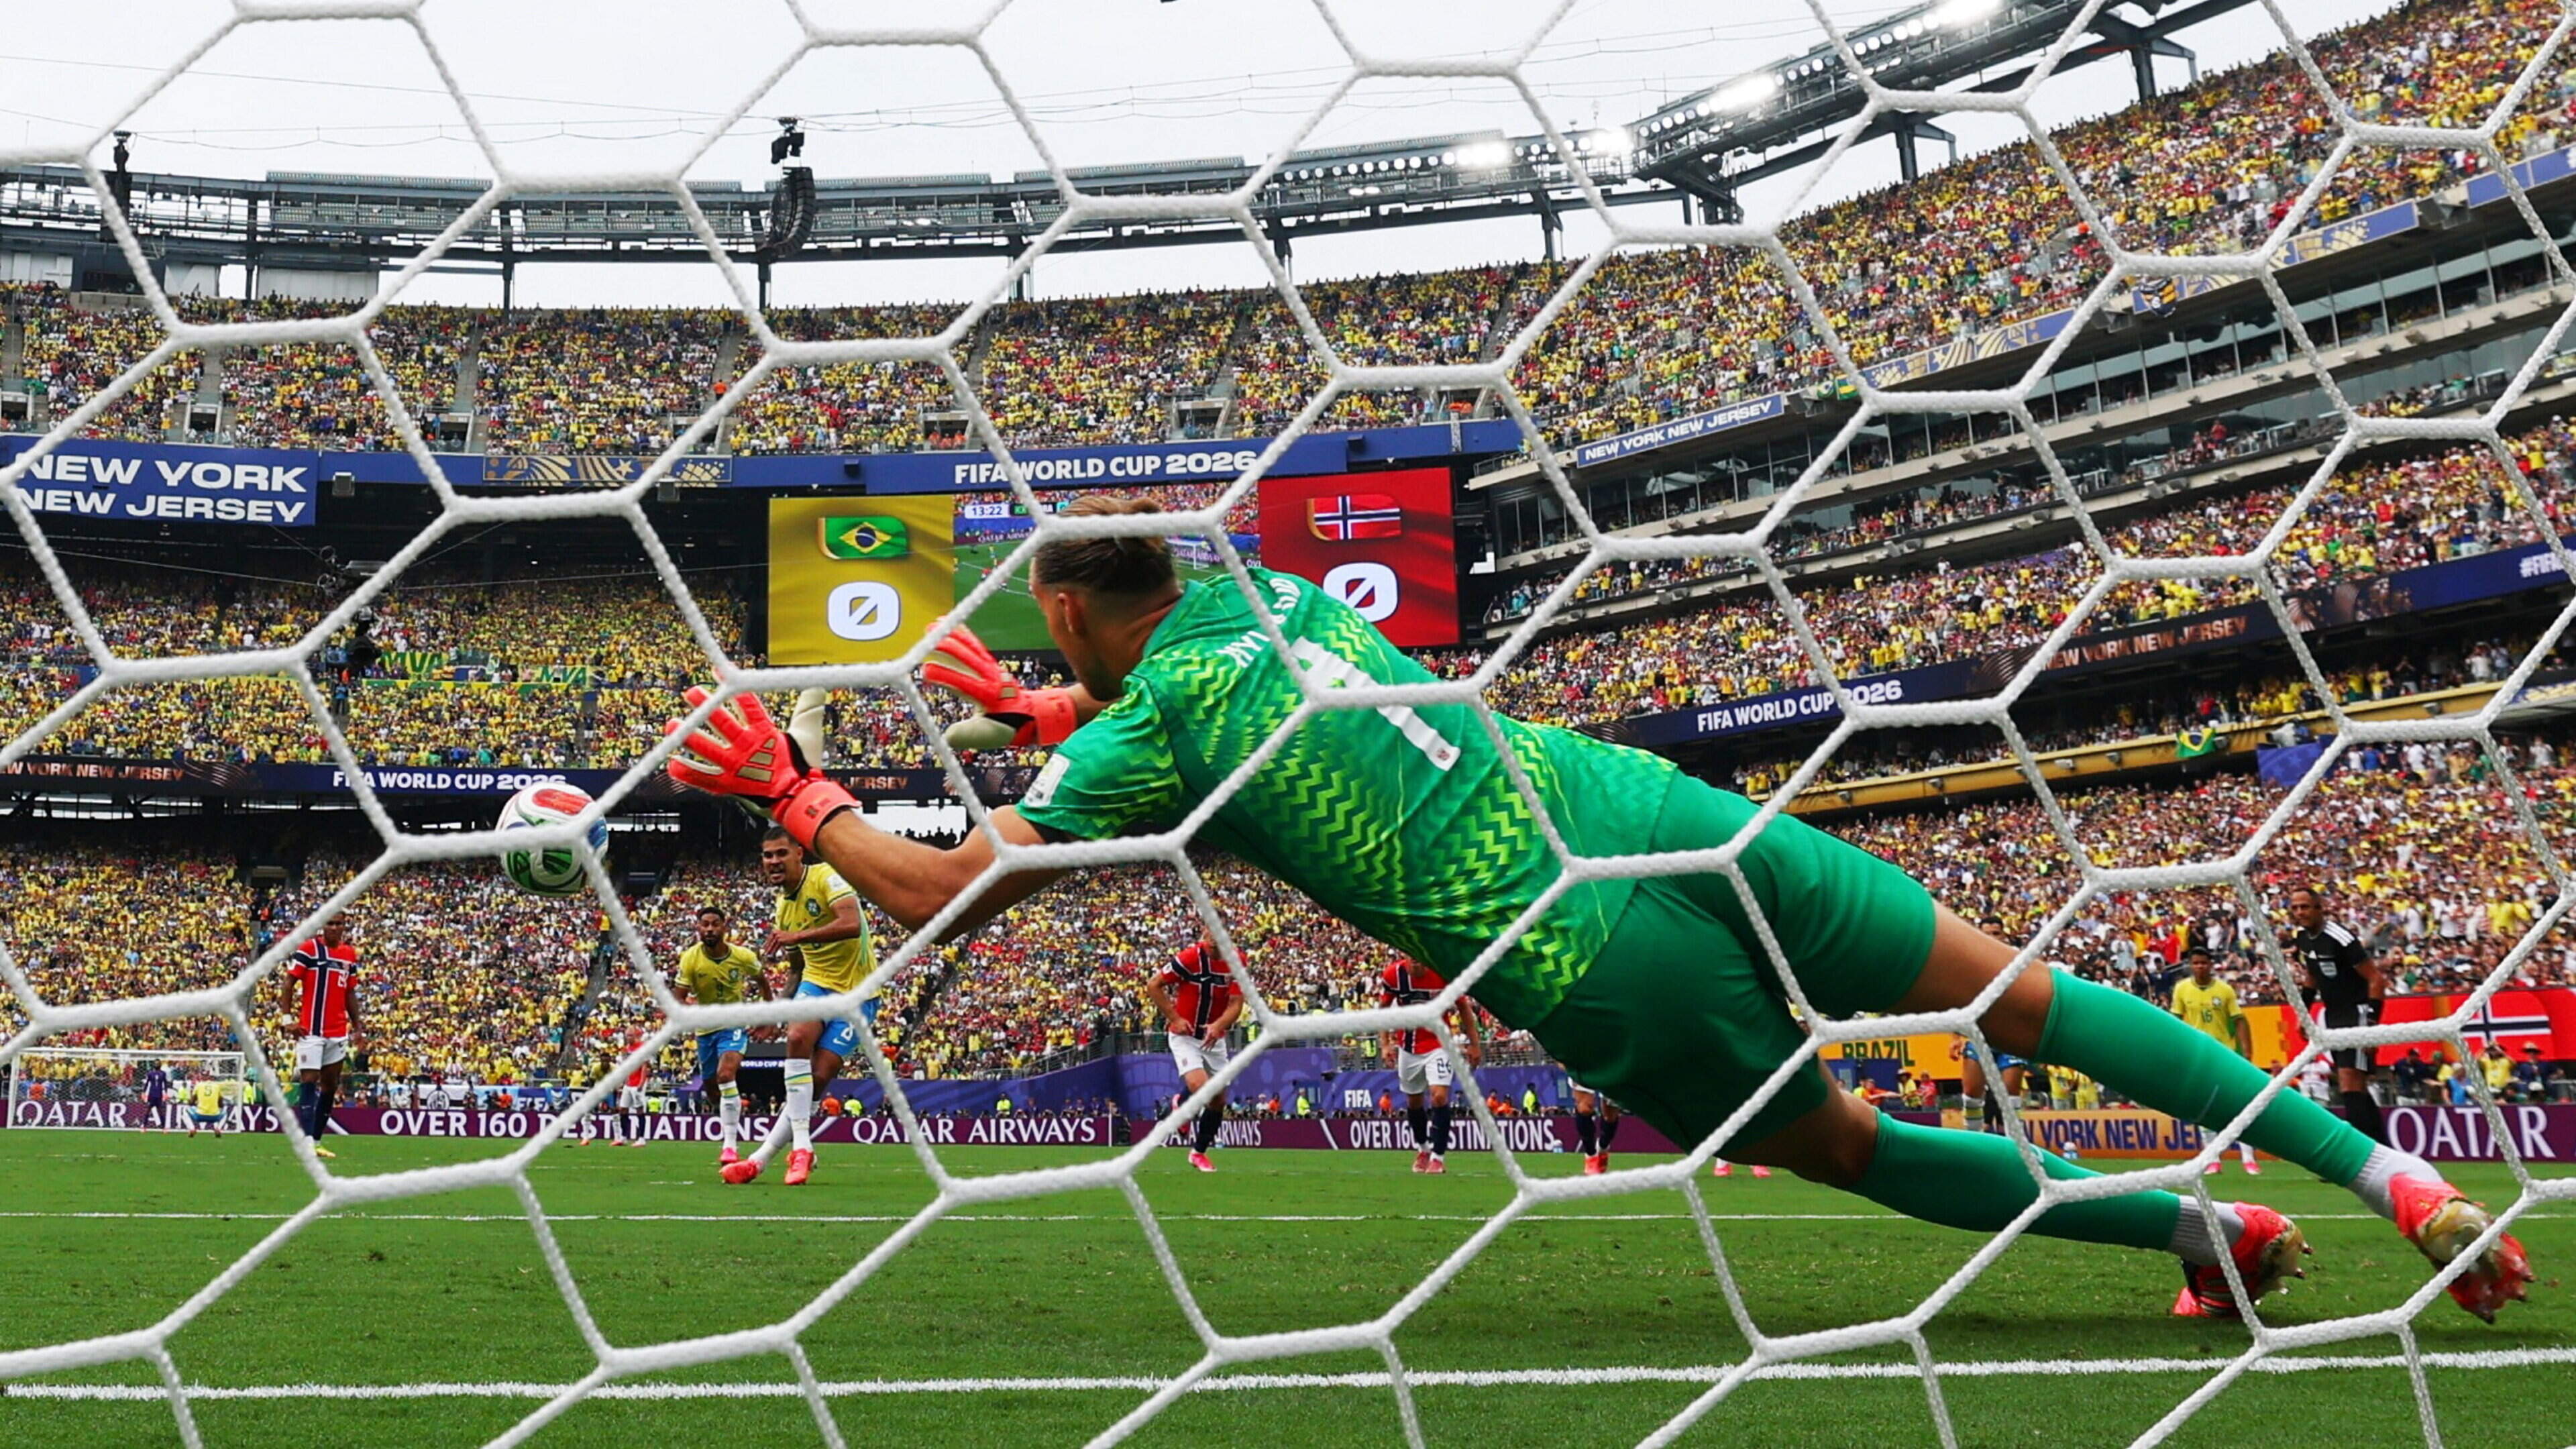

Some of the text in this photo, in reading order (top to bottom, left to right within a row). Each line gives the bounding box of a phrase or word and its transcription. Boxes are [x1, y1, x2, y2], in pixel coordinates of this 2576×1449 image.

[1585, 400, 1772, 461] NEW YORK NEW JERSEY
[15, 452, 308, 492] NEW YORK
[955, 450, 1256, 484] FIFA WORLD CUP 2026
[17, 488, 306, 523] NEW JERSEY
[973, 506, 1002, 516] 13:22
[2082, 639, 2131, 662] YORK
[2134, 631, 2175, 653] NEW
[2178, 615, 2247, 645] JERSEY
[1697, 709, 1733, 732] FIFA
[1734, 698, 1797, 726] WORLD
[1799, 692, 1834, 714] CUP
[76, 763, 115, 778] NEW
[379, 772, 451, 790] WORLD
[455, 773, 494, 790] CUP
[1344, 1089, 1373, 1108] FIFA
[17, 1100, 279, 1132] QATAR AIRAYS
[380, 1110, 468, 1136] OVER
[478, 1112, 528, 1138] 160
[969, 1118, 1096, 1143] AIRWAYS
[1350, 1120, 1392, 1149] OVER
[2039, 1118, 2101, 1150] YORK
[2104, 1119, 2157, 1150] NEW
[2387, 1106, 2556, 1159] QATAR
